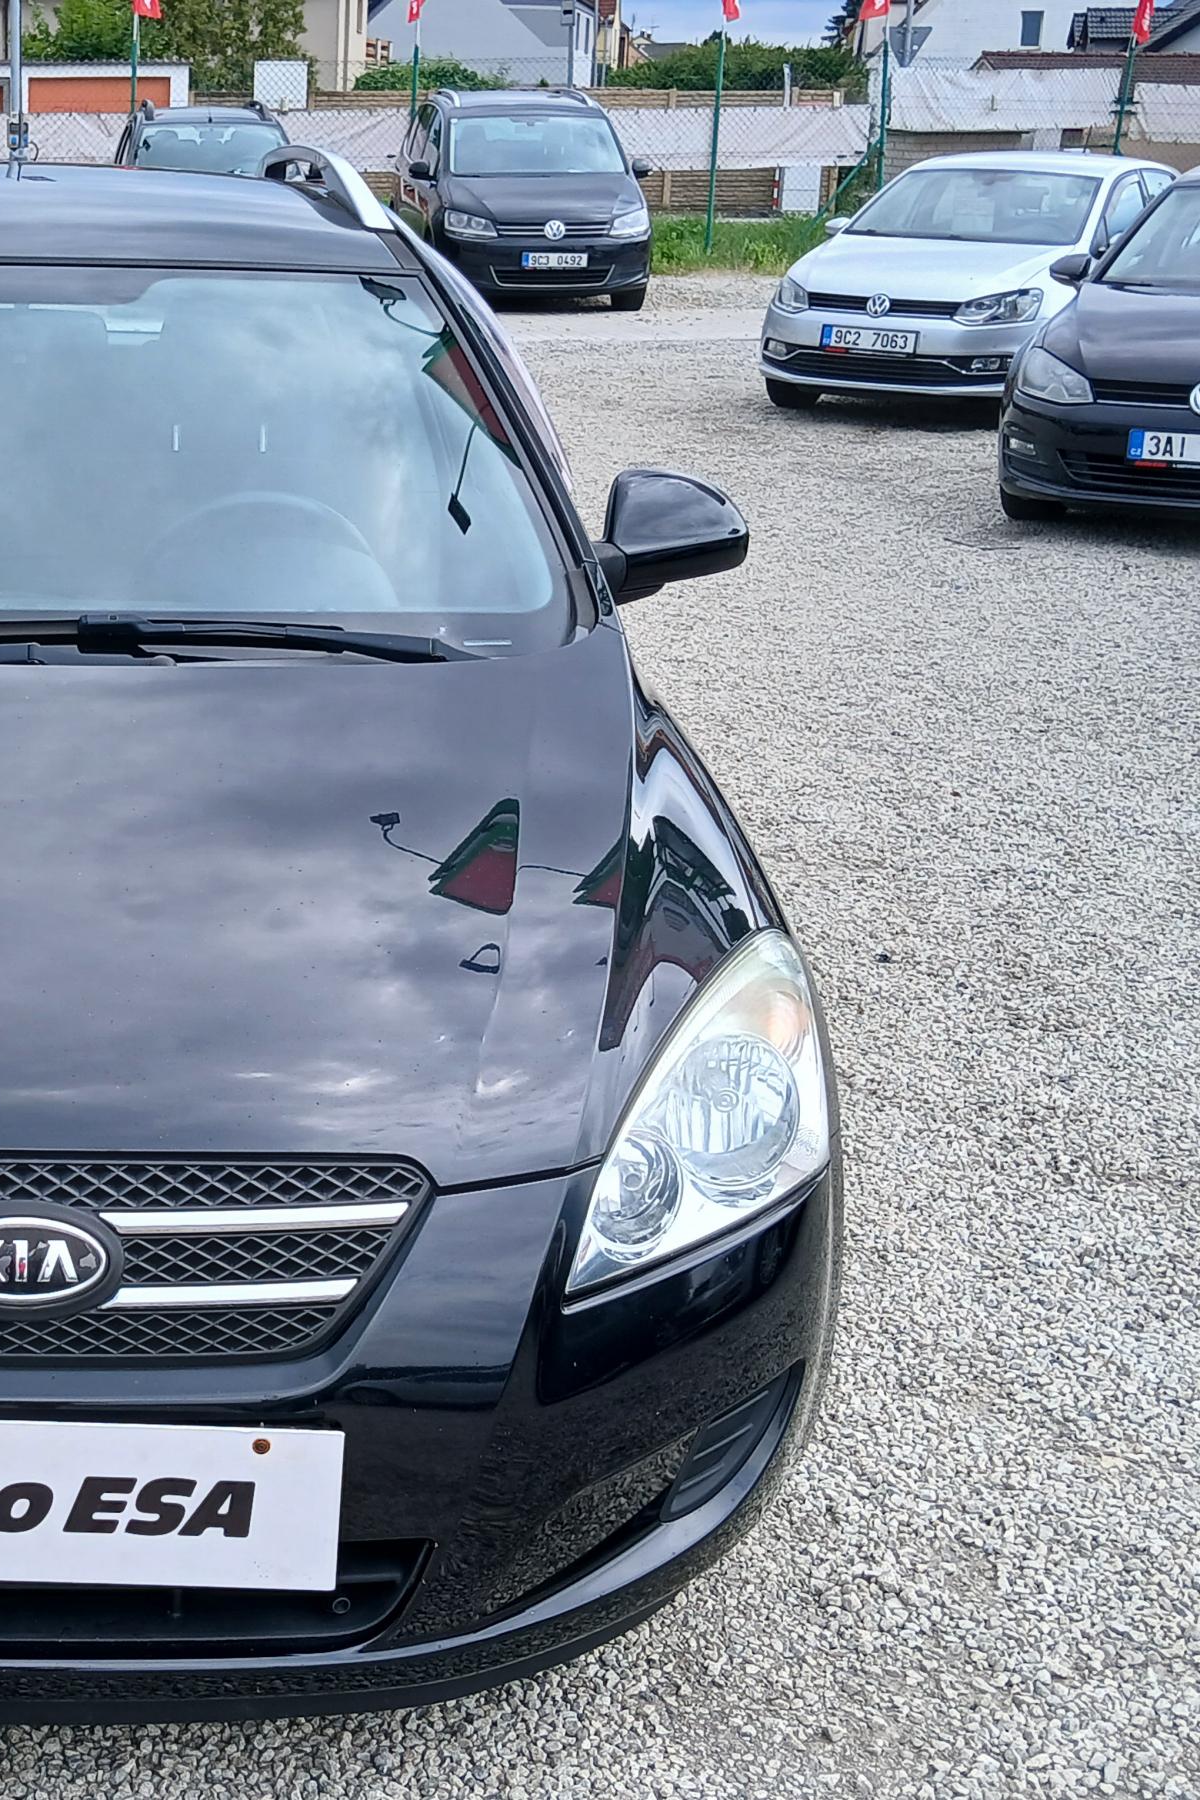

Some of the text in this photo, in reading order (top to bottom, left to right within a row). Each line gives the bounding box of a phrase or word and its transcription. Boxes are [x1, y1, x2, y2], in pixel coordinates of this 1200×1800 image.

[531, 255, 583, 266] 9C3 0492
[834, 329, 861, 346] 9C2
[871, 332, 909, 350] 7063
[62, 1476, 256, 1538] ESA
